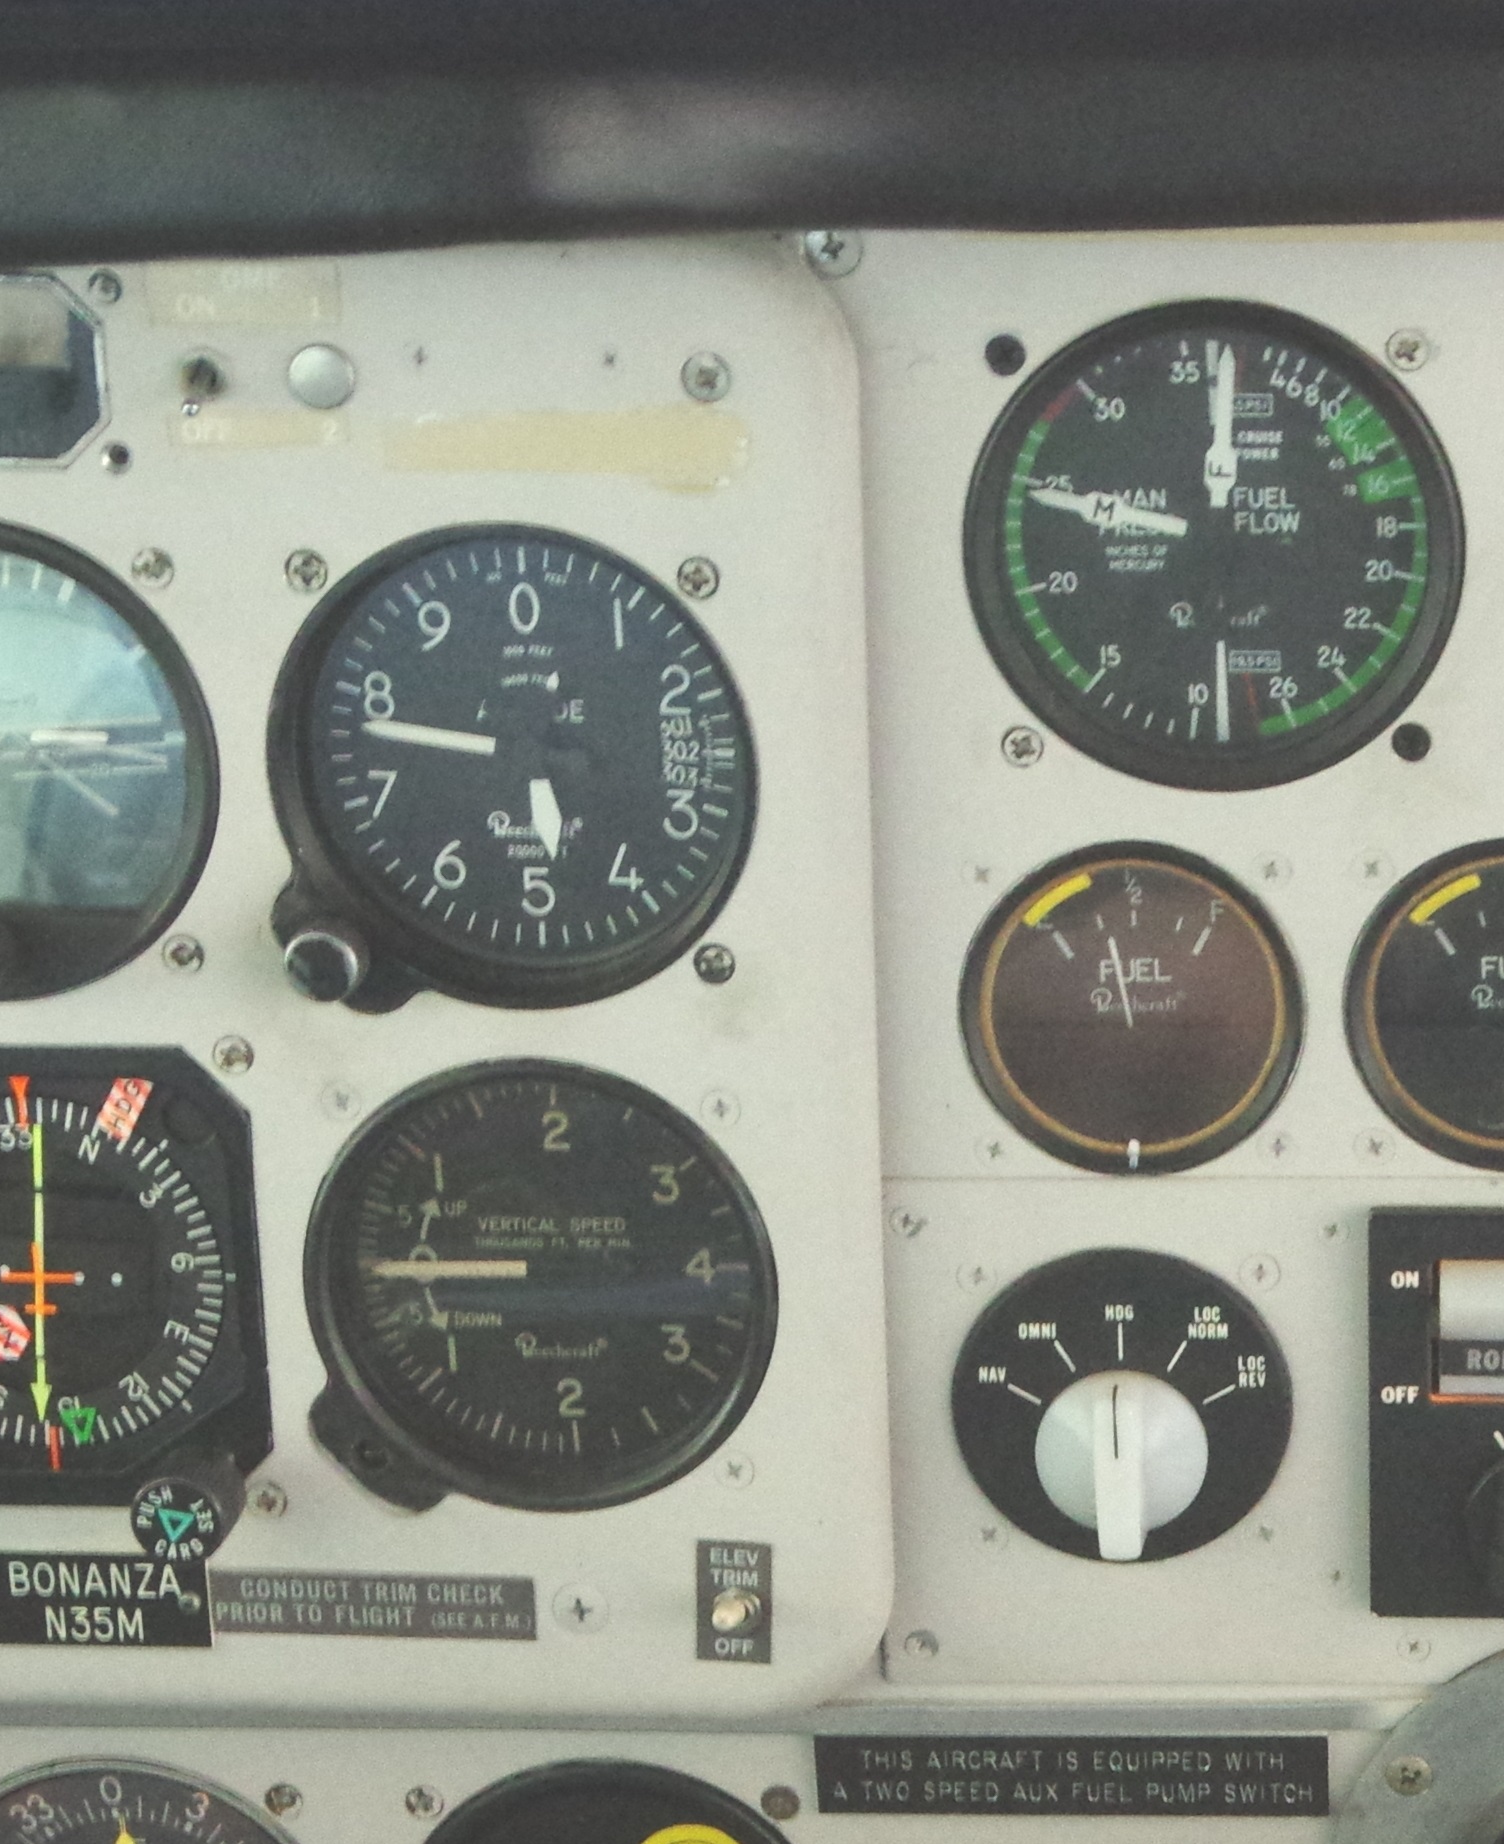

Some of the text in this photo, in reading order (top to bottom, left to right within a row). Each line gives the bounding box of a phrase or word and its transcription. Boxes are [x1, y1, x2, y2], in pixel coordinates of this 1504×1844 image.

[1233, 487, 1295, 510] FUEL
[1233, 512, 1300, 534] FLOW
[508, 581, 540, 634] 0
[418, 601, 451, 651] 9
[363, 671, 395, 720] 8
[660, 664, 692, 716] 2
[521, 866, 555, 916] 5
[444, 1200, 467, 1216] UP
[478, 1216, 626, 1232] VERTICAL SPEED
[1391, 1271, 1419, 1289] ON
[1105, 1304, 1134, 1321] HDG
[1019, 1323, 1056, 1340] OMNI
[1188, 1323, 1228, 1339] NORM
[979, 1366, 1006, 1383] NAV
[1381, 1386, 1419, 1404] OFF
[710, 1549, 759, 1568] ELEV
[8, 1561, 181, 1599] BONANZA
[711, 1568, 758, 1586] TRIM
[240, 1579, 504, 1606] CONDUCT TRIM CHECK
[46, 1605, 144, 1642] N35M
[216, 1604, 415, 1628] PRIOR TO FLIGHT
[715, 1639, 754, 1657] OFF
[861, 1751, 1285, 1772] THIS AIRCRAFT IS EQUIPPED WITH
[834, 1782, 1312, 1803] A TWO SPEED AUX FUEL PUMP SWITCH
